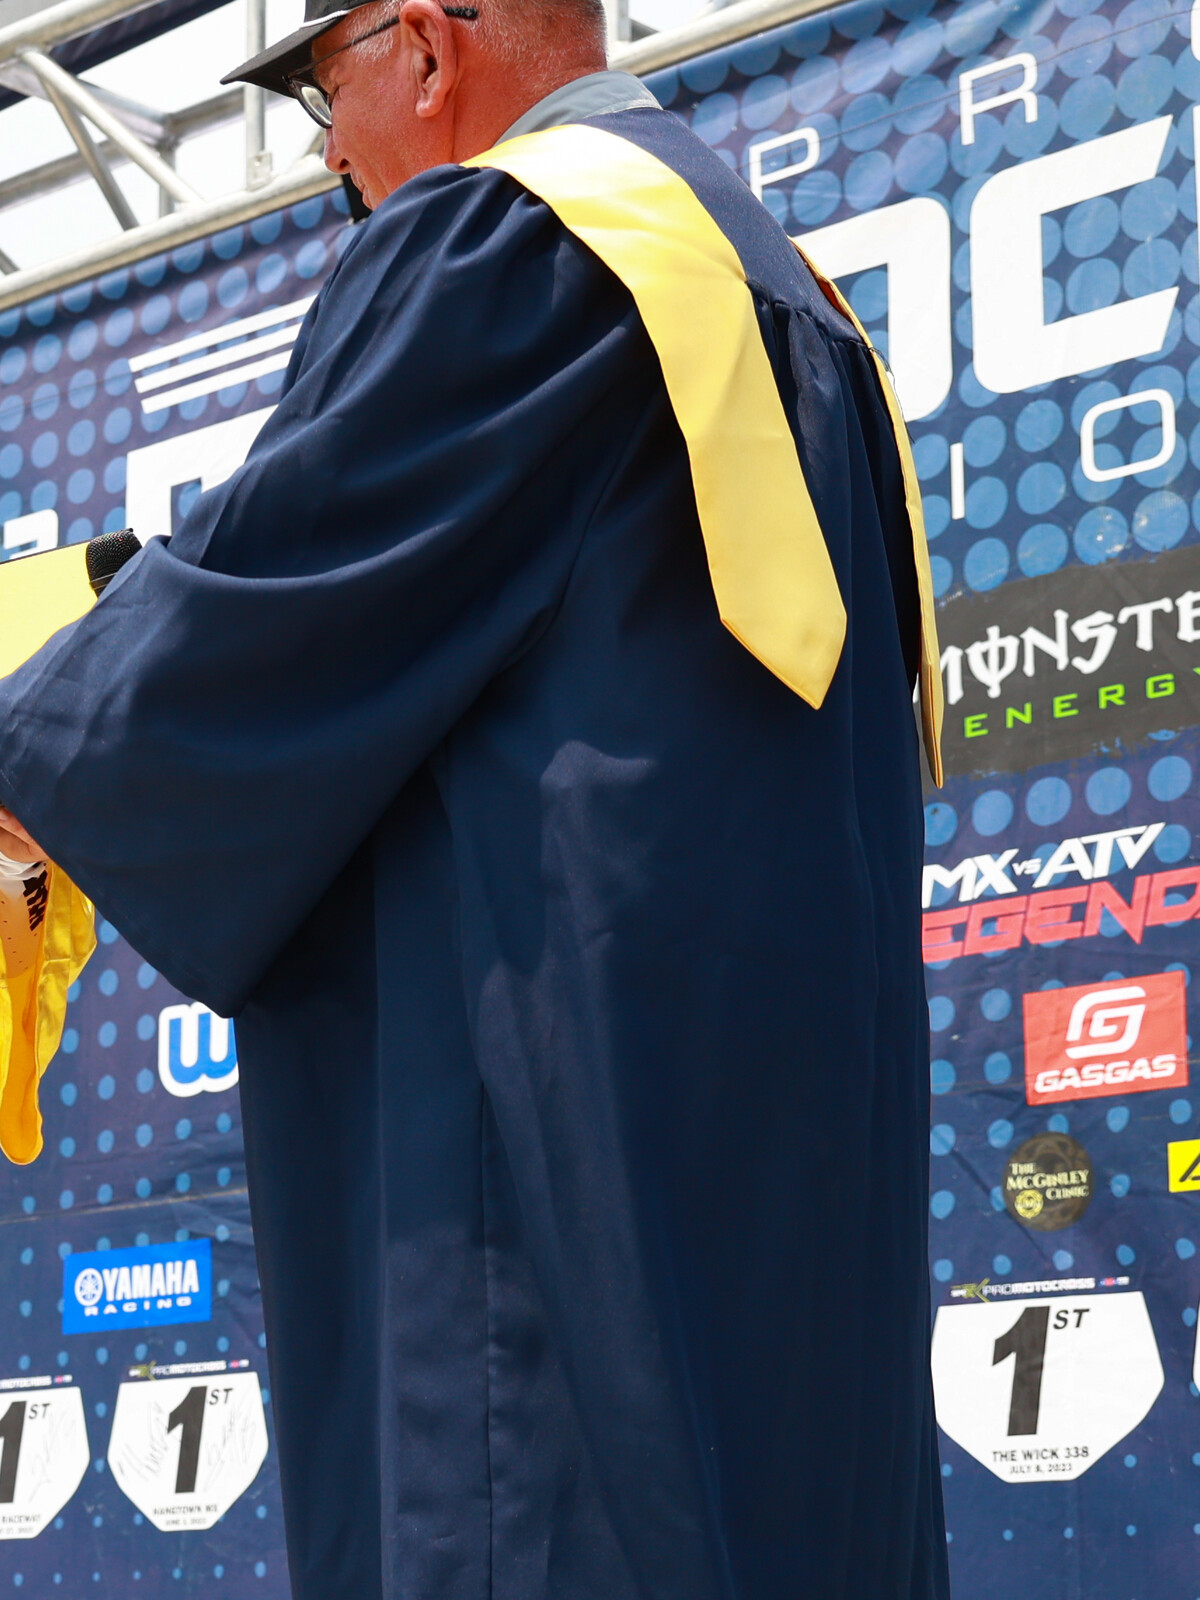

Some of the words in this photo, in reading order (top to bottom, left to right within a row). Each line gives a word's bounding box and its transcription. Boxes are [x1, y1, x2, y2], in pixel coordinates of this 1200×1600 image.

[964, 667, 1200, 738] ENERG
[1032, 821, 1166, 888] ATV
[922, 865, 1200, 964] EGEND
[1034, 1053, 1177, 1094] GASGAS
[102, 1259, 200, 1302] YAMAHA
[84, 1295, 193, 1317] RACING
[992, 1449, 1017, 1462] THE
[1022, 1447, 1059, 1460] WICK
